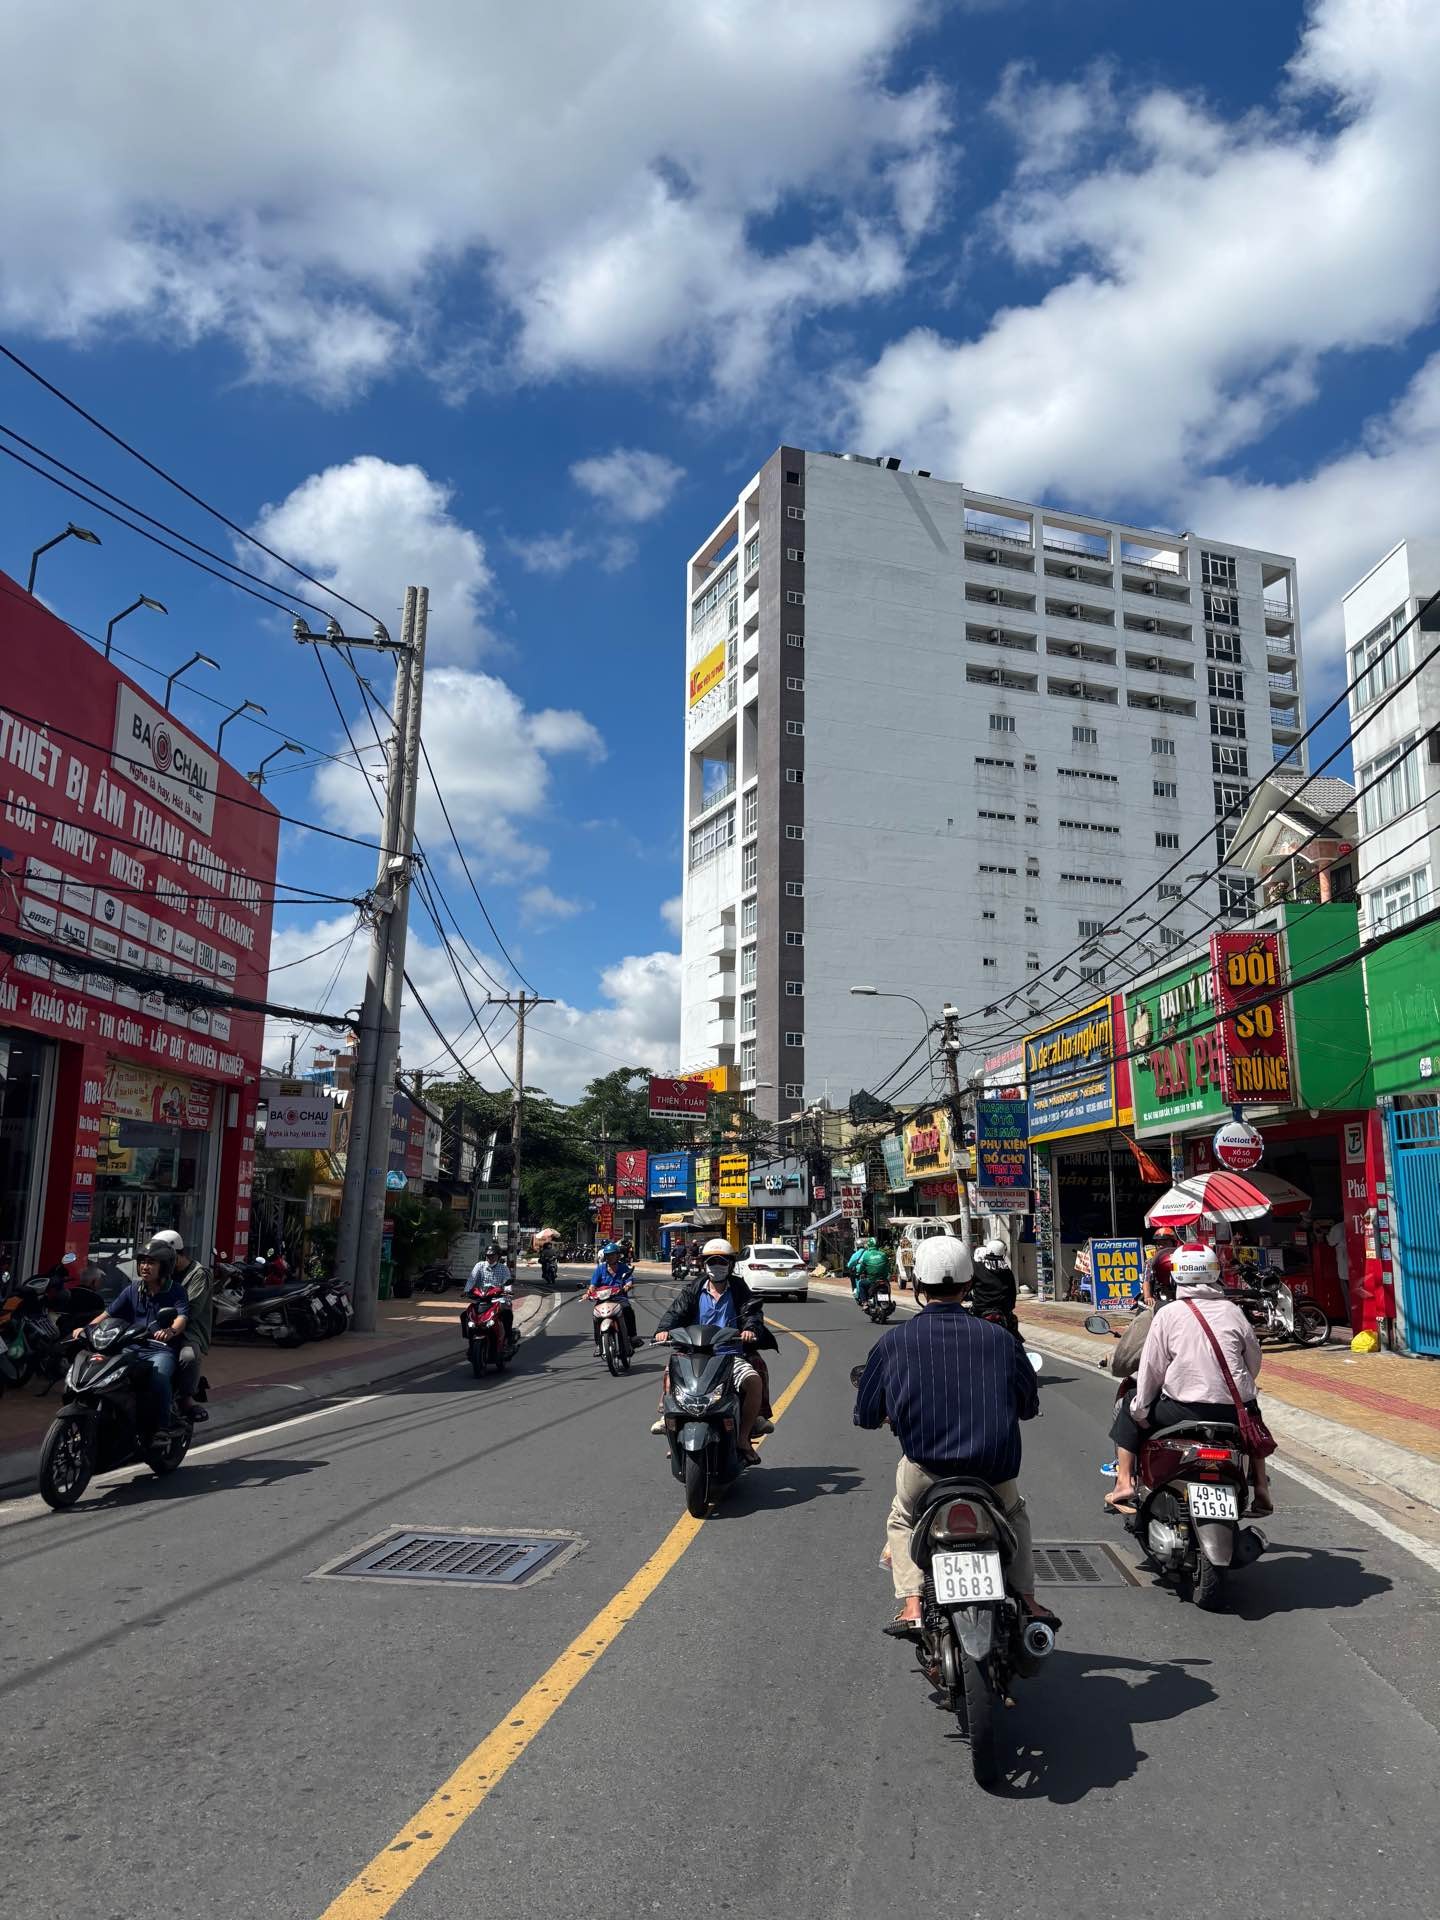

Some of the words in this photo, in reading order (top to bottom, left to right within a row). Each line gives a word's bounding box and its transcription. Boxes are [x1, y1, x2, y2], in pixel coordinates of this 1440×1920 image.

[65, 756, 89, 814] BỊ
[93, 769, 126, 829] ÂM
[132, 802, 184, 866] THANH
[5, 789, 36, 834] LOA
[110, 848, 145, 891] MIXER
[218, 911, 255, 950] KARAOKE
[29, 911, 55, 927] BOSE
[1228, 939, 1276, 986] ĐỔI
[1160, 988, 1180, 1022] ĐẠI
[30, 989, 64, 1024] KHẢO
[66, 1001, 88, 1031] SÁT
[99, 1012, 115, 1039] THI
[117, 1016, 143, 1047] CÔNG
[1233, 1049, 1288, 1091] TRÚNG
[299, 1111, 328, 1121] CHAU
[991, 1114, 999, 1125] Ô
[1000, 1114, 1014, 1125] TÔ
[980, 1140, 1001, 1152] PHỤ
[1004, 1139, 1027, 1152] KIỆN
[1223, 1136, 1250, 1144] Vietlott
[765, 1175, 783, 1190] GS25
[979, 1199, 1025, 1209] mobifone
[1097, 1250, 1138, 1266] DÁN
[1099, 1267, 1138, 1282] KEO
[1108, 1283, 1132, 1298] XE
[1197, 1487, 1227, 1502] 49-G1
[1193, 1501, 1234, 1517] 515.94
[944, 1554, 988, 1575] 54-N1
[946, 1576, 994, 1598] 9683
